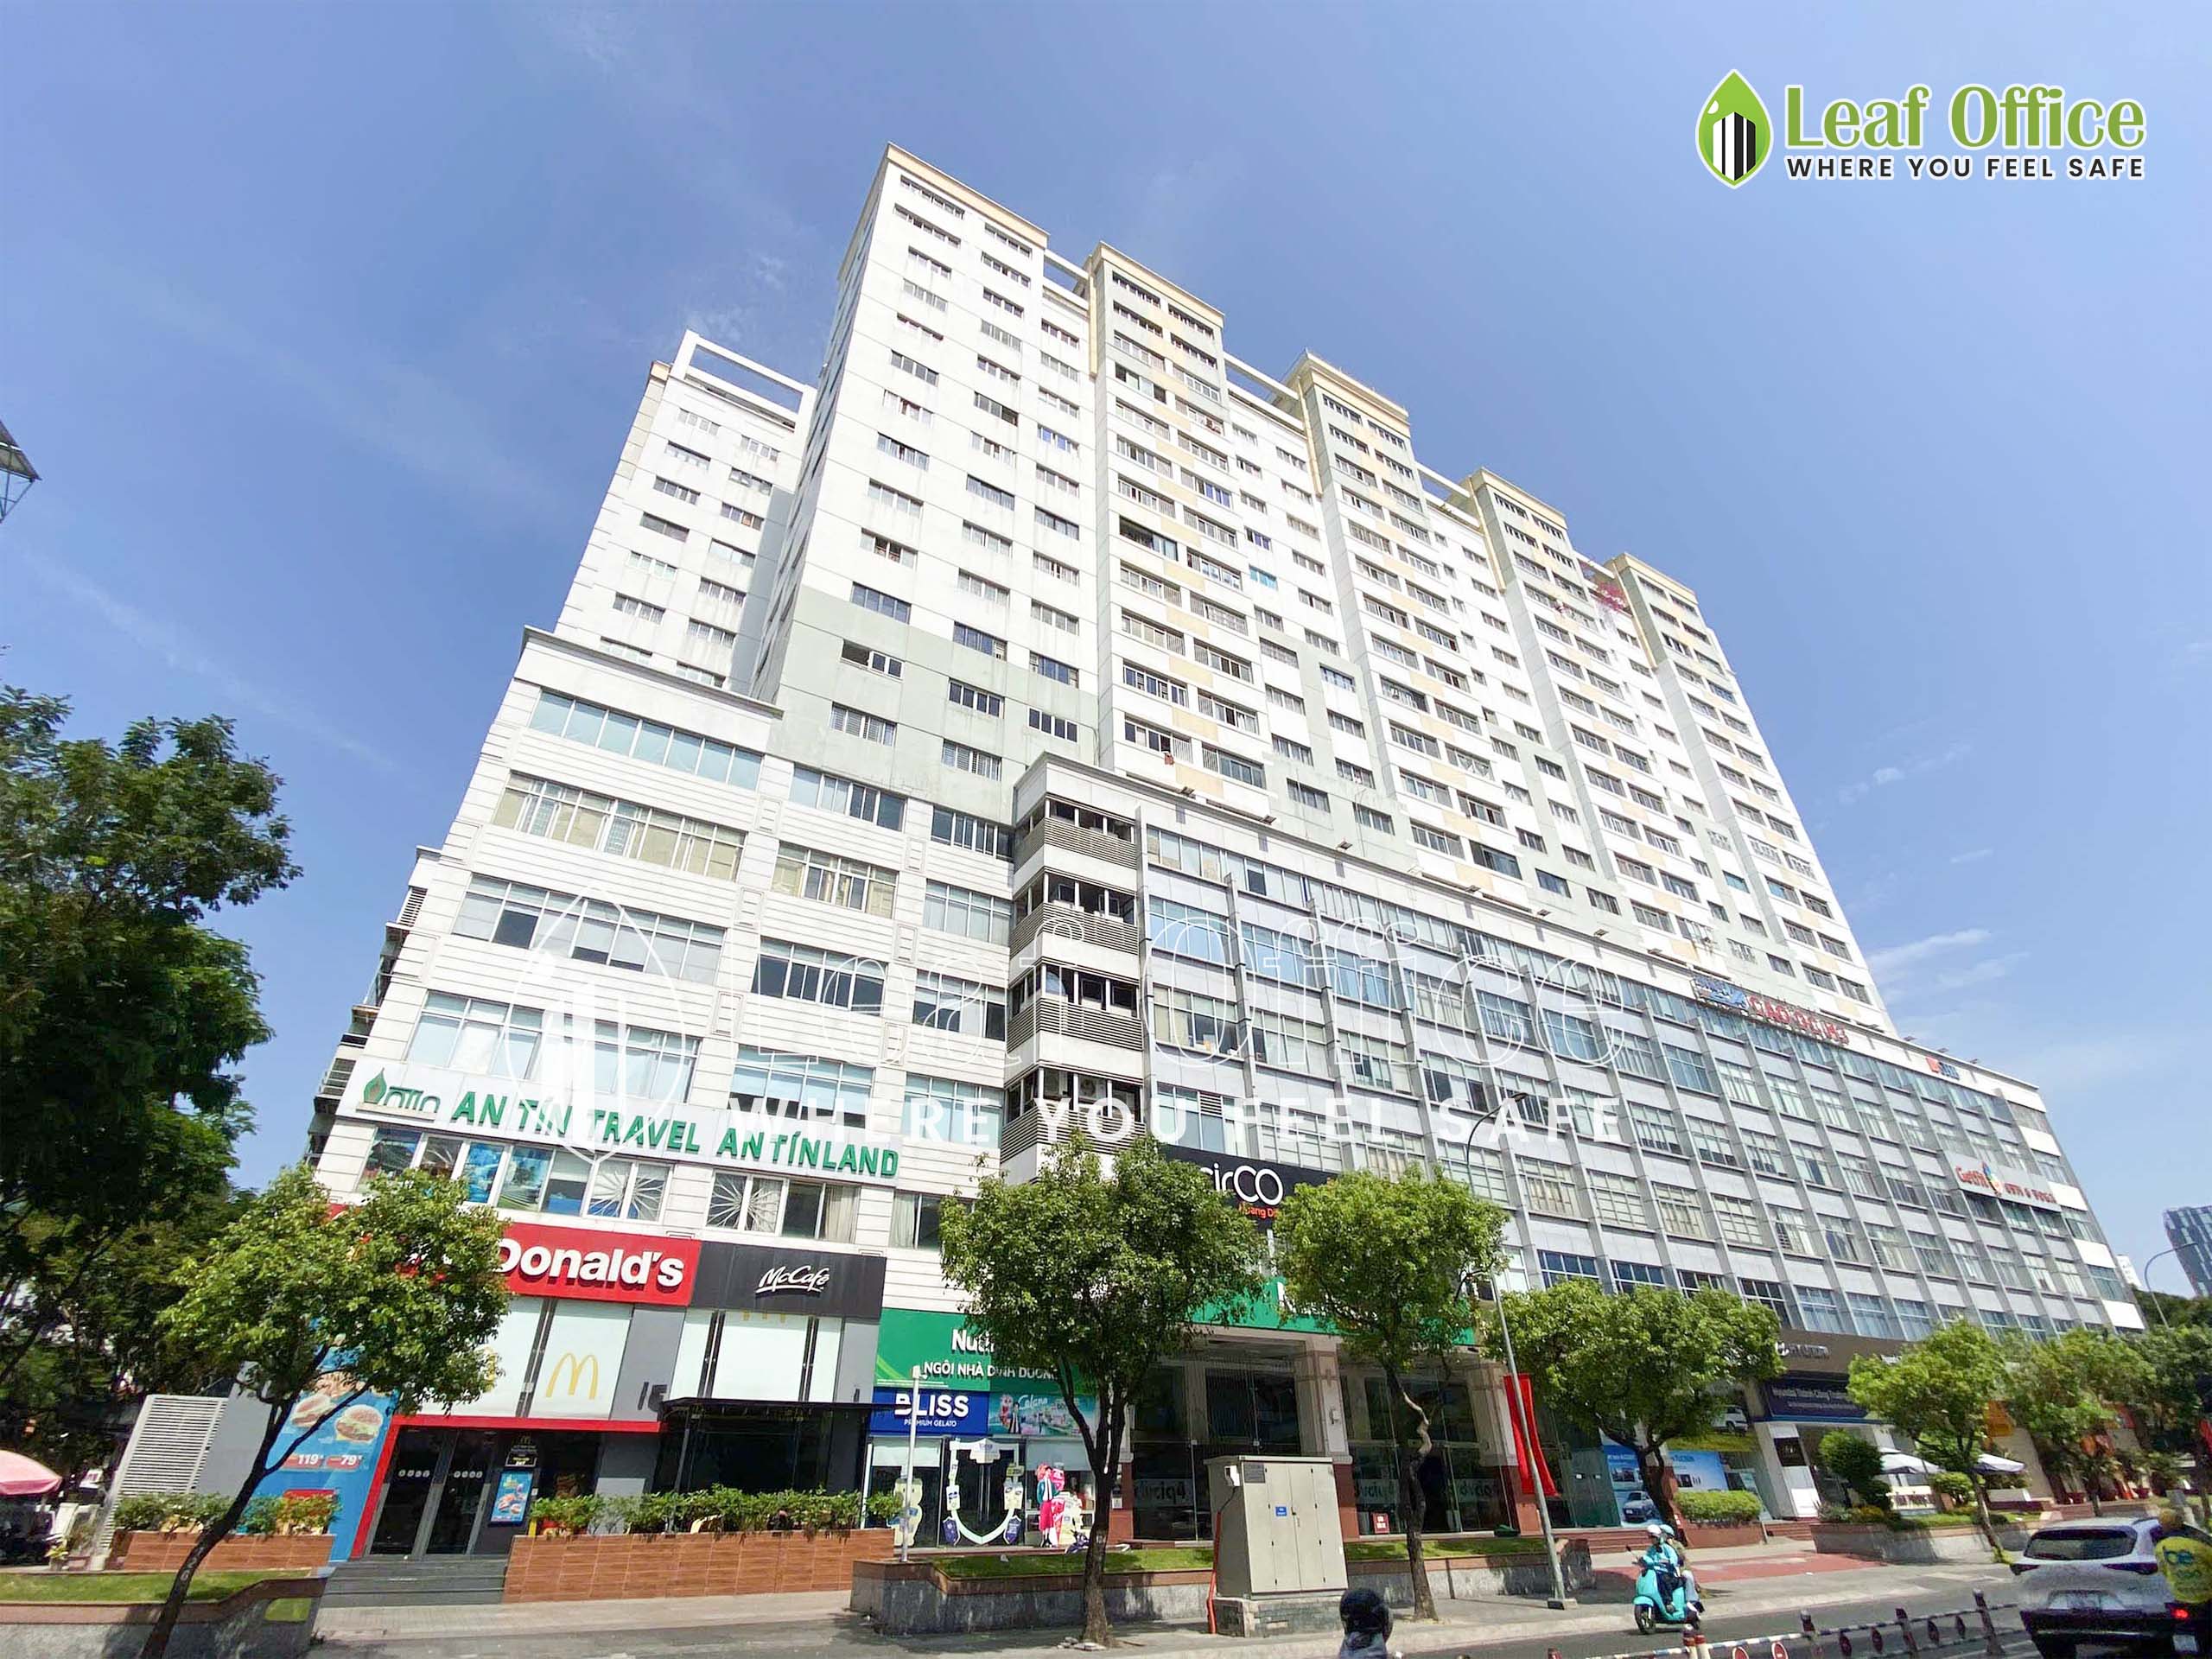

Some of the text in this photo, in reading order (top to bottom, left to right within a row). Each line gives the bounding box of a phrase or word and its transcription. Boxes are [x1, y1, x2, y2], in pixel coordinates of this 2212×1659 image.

[450, 1090, 508, 1128] AN
[586, 1108, 701, 1154] TRAVEL
[491, 1236, 684, 1288] Donald's
[755, 1264, 830, 1294] McCafé
[924, 1359, 955, 1375] NGÔI
[957, 1361, 984, 1376] NHÀ
[894, 1393, 969, 1418] BLISS
